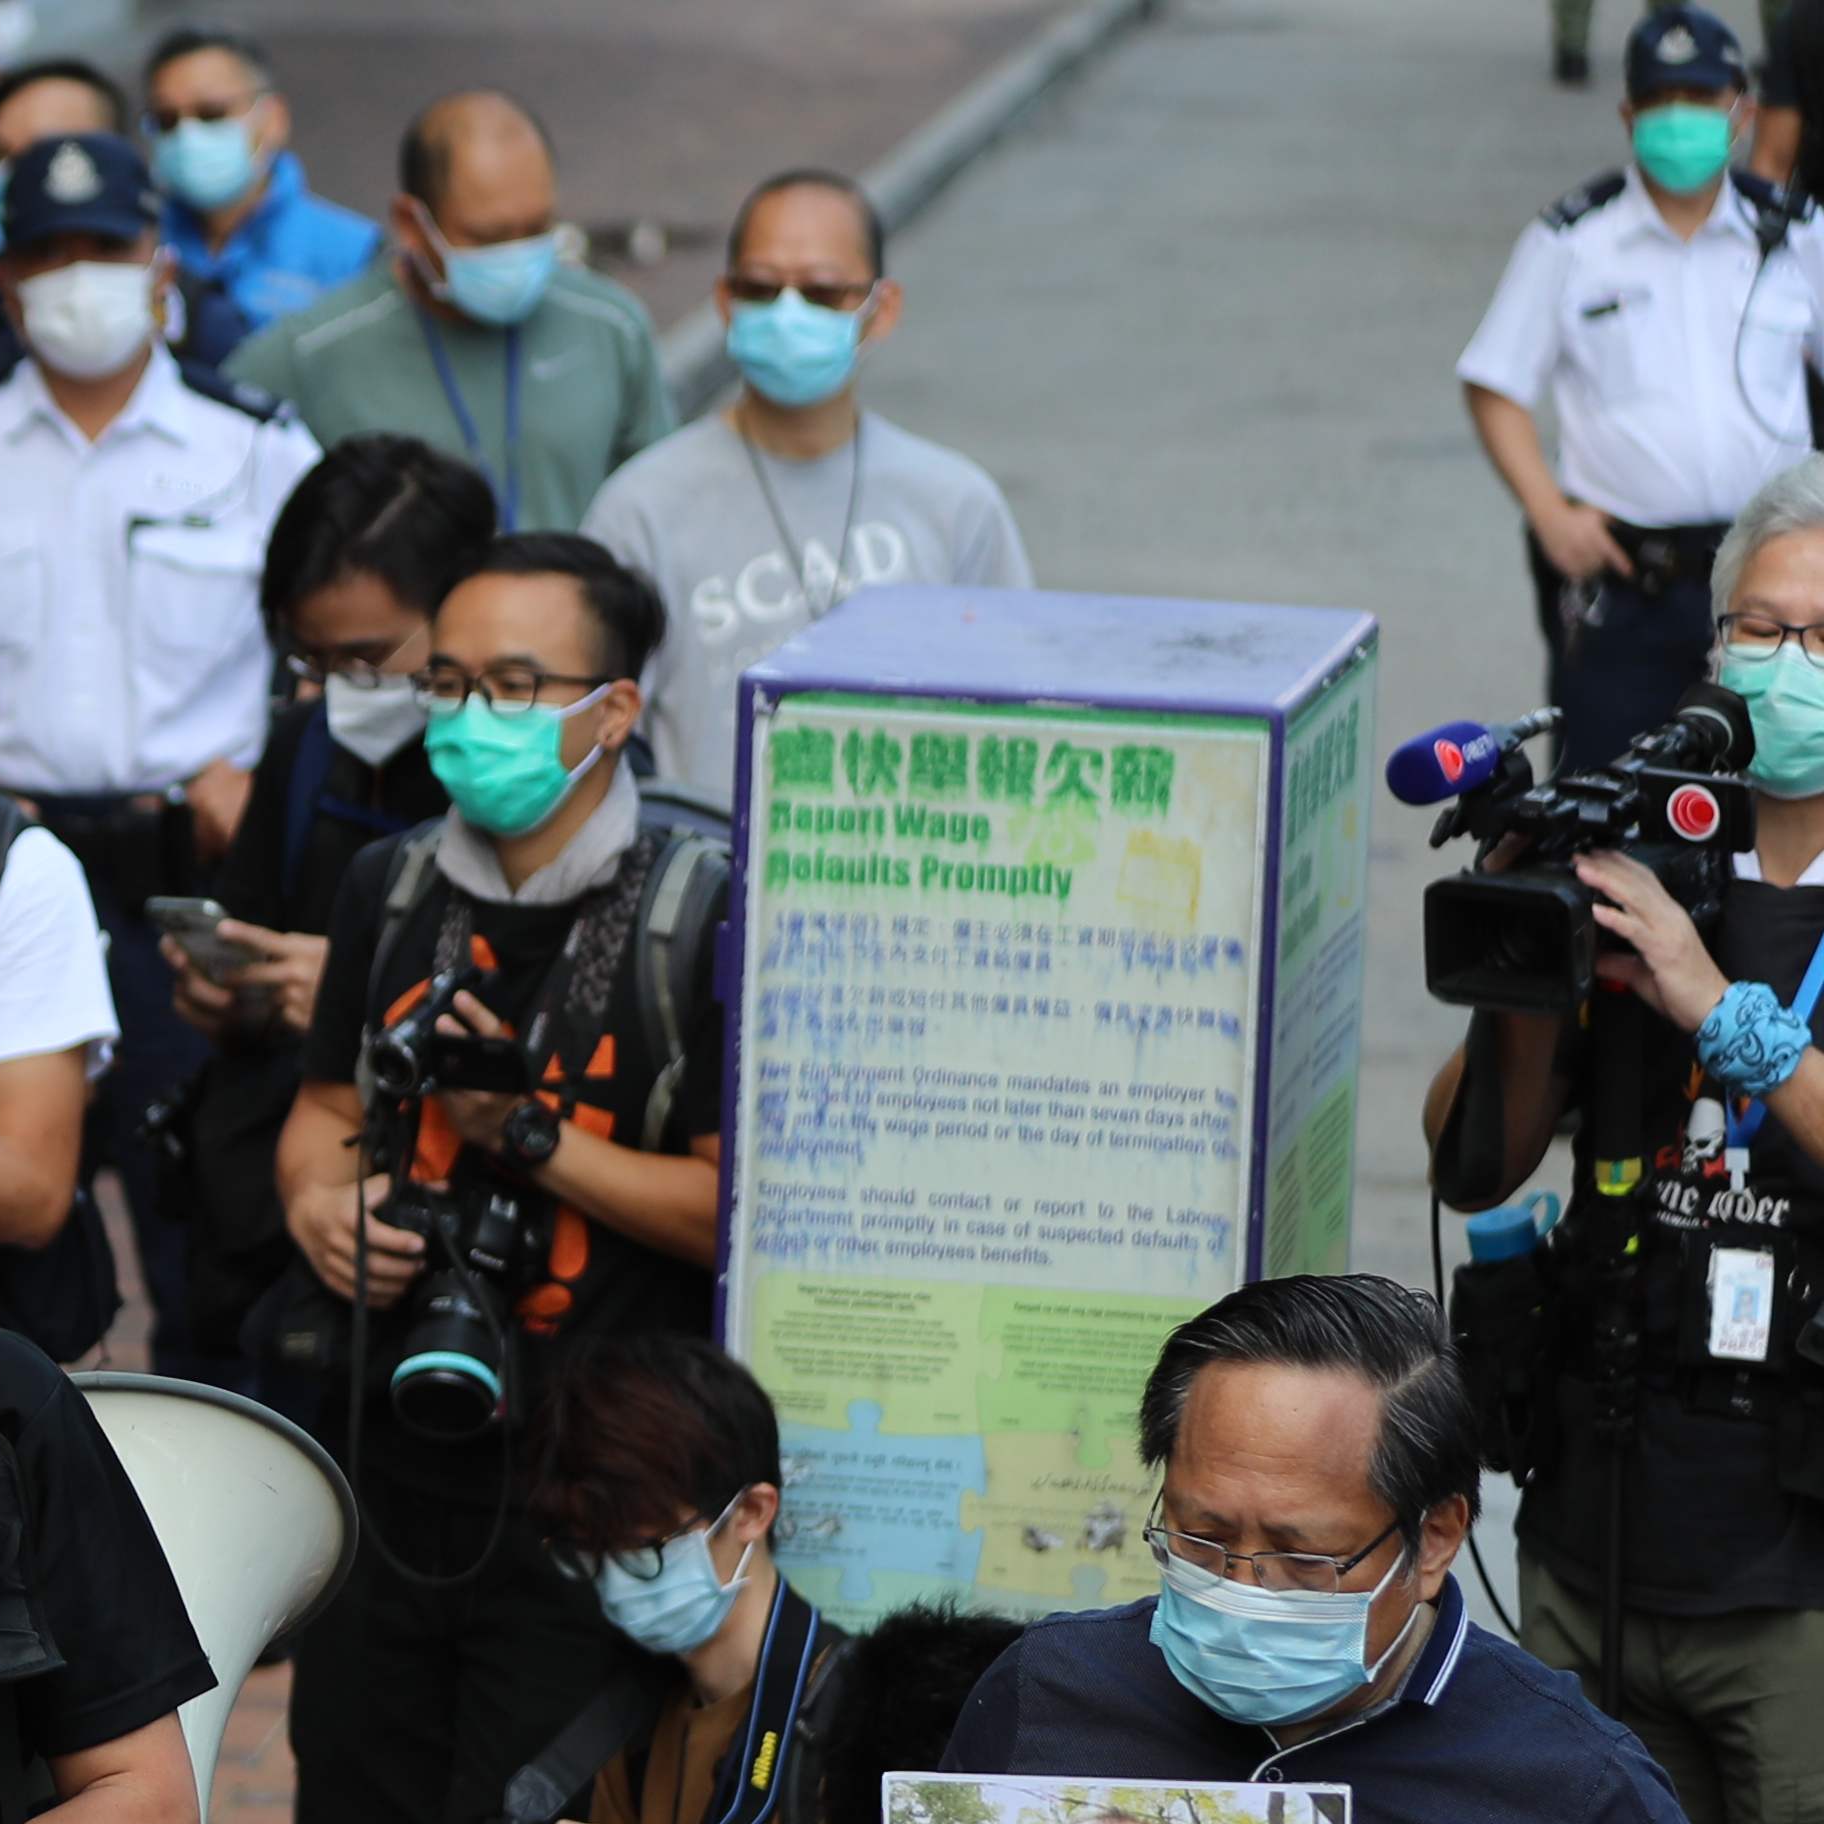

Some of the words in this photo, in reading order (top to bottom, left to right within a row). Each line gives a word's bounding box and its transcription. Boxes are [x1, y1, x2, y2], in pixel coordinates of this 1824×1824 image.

[893, 804, 990, 843] Wage
[921, 853, 1072, 899] Promptly
[912, 1065, 998, 1087] Ordinance
[1007, 1074, 1090, 1094] mandates
[1098, 1080, 1119, 1095] an
[1128, 1081, 1206, 1104] employer
[876, 1092, 966, 1113] employees
[972, 1096, 999, 1113] not
[1004, 1100, 1042, 1117] later
[1049, 1102, 1084, 1119] than
[1091, 1106, 1140, 1123] seven
[1145, 1108, 1184, 1129] days
[884, 1118, 929, 1138] wage
[935, 1118, 988, 1140] period
[994, 1124, 1011, 1140] or
[1018, 1123, 1044, 1142] the
[1051, 1126, 1080, 1148] day
[1087, 1127, 1103, 1145] of
[1109, 1130, 1204, 1154] termination
[759, 1178, 848, 1203] Employees
[861, 1185, 916, 1206] should
[929, 1191, 992, 1211] contact
[1004, 1196, 1021, 1212] or
[1034, 1199, 1085, 1219] report
[1098, 1200, 1113, 1218] to
[1128, 1202, 1153, 1221] the
[756, 1204, 853, 1230] Department
[861, 1213, 935, 1234] promptly
[944, 1216, 958, 1233] in
[967, 1219, 1005, 1236] case
[1013, 1220, 1031, 1238] of
[1038, 1224, 1124, 1246] suspected
[837, 1236, 879, 1253] other
[885, 1240, 975, 1261] employees
[980, 1243, 1054, 1265] benefits.
[751, 1731, 777, 1790] Nikon
